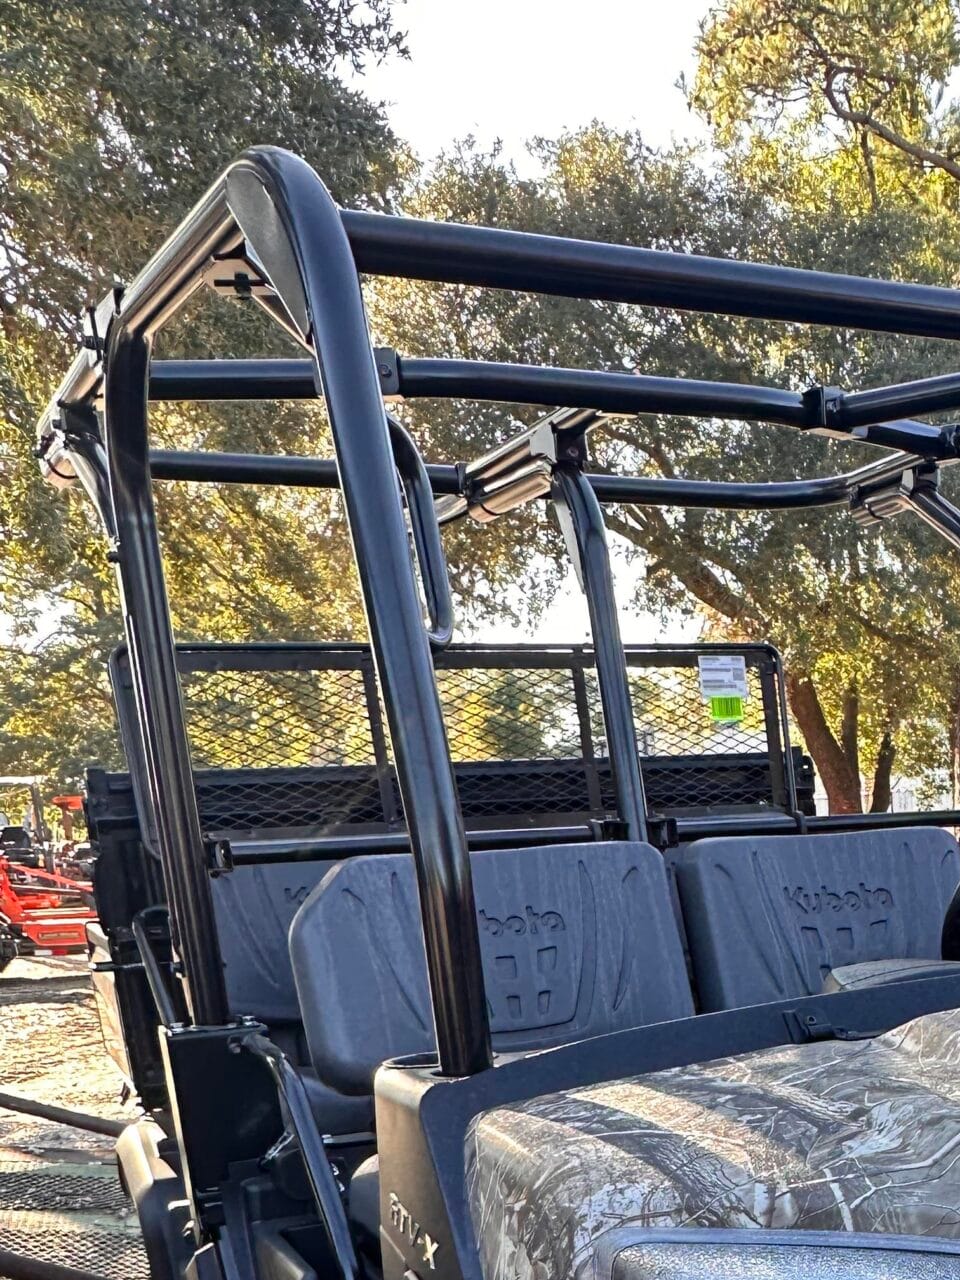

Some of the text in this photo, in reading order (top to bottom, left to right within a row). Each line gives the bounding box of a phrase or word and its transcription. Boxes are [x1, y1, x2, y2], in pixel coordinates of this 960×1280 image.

[783, 882, 894, 914] Kubota
[479, 905, 566, 937] bota
[389, 1192, 439, 1270] RTV-X
